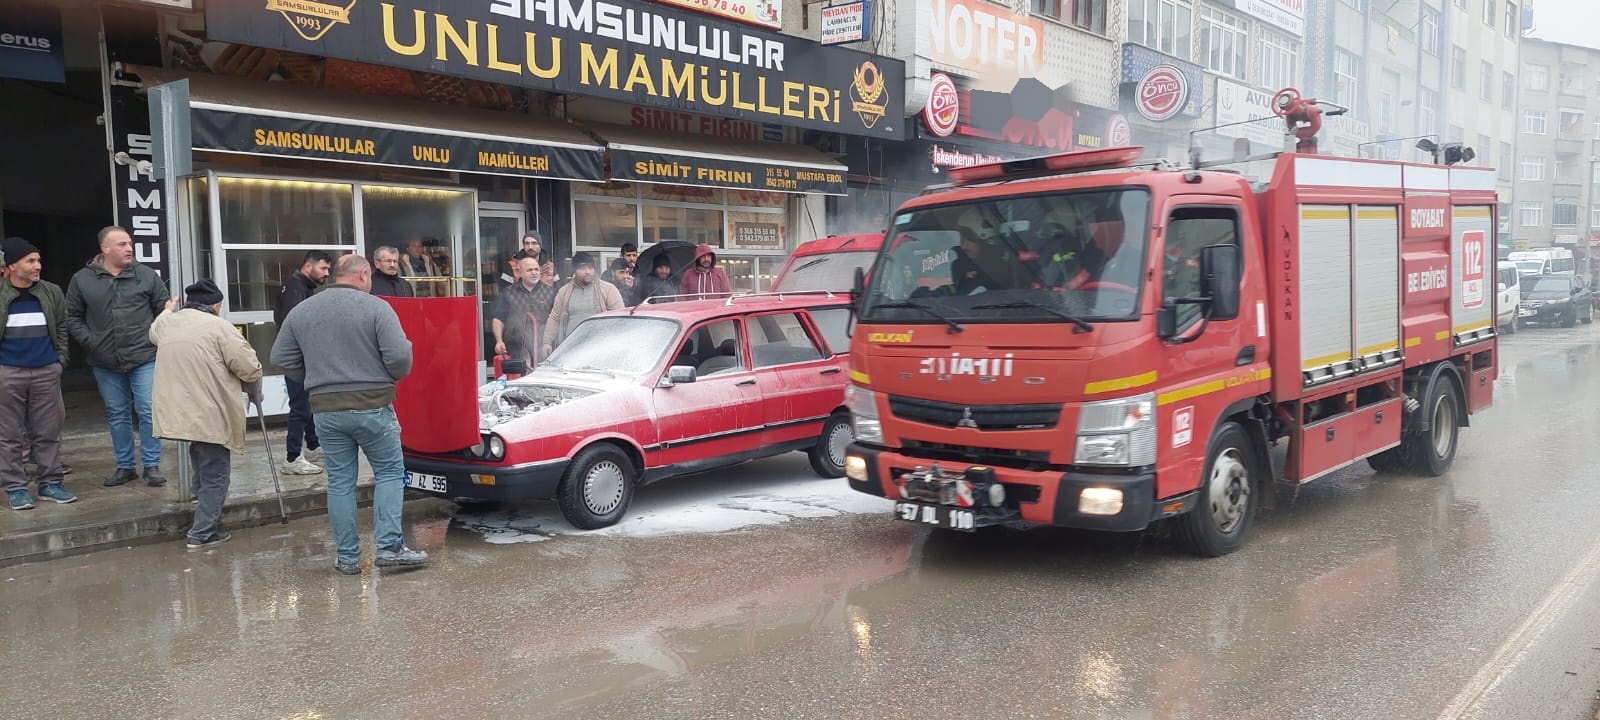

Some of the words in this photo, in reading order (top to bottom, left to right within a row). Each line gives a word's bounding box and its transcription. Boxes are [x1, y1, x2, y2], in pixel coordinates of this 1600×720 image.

[713, 0, 728, 10] 78
[731, 3, 746, 15] 40
[823, 7, 849, 17] MEYDAN
[296, 15, 321, 31] 1993
[381, 3, 562, 79] UNLU
[930, 0, 1037, 73] NOTER
[254, 128, 376, 157] SAMSUNLULAR
[412, 145, 450, 164] UNLU
[478, 151, 549, 171] MAMÜLLERİ
[635, 160, 692, 178] SİMİT
[697, 167, 753, 184] FIRINI
[796, 170, 826, 182] MUSTAFA
[826, 173, 843, 184] EROL
[1411, 208, 1445, 228] BOYABAT
[1465, 240, 1482, 275] 112
[1407, 264, 1447, 293] BEEDİYESİ
[432, 476, 446, 492] 595
